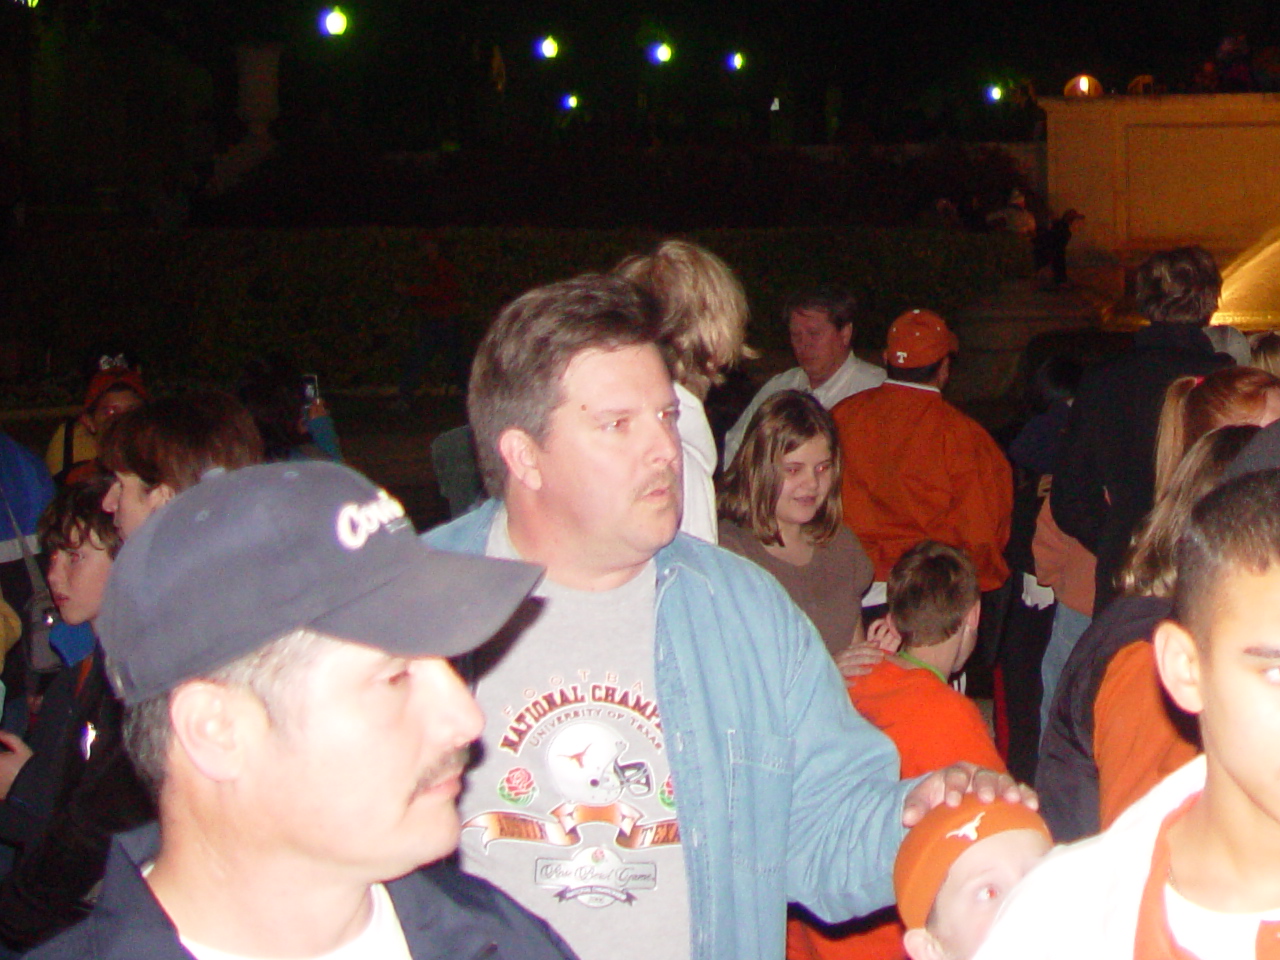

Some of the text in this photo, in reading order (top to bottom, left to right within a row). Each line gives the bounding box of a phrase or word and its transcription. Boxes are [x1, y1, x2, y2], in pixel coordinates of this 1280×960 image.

[897, 352, 907, 363] T
[499, 683, 589, 756] NATIONAL
[529, 708, 603, 747] UNIVERSITY
[606, 711, 626, 722] OF
